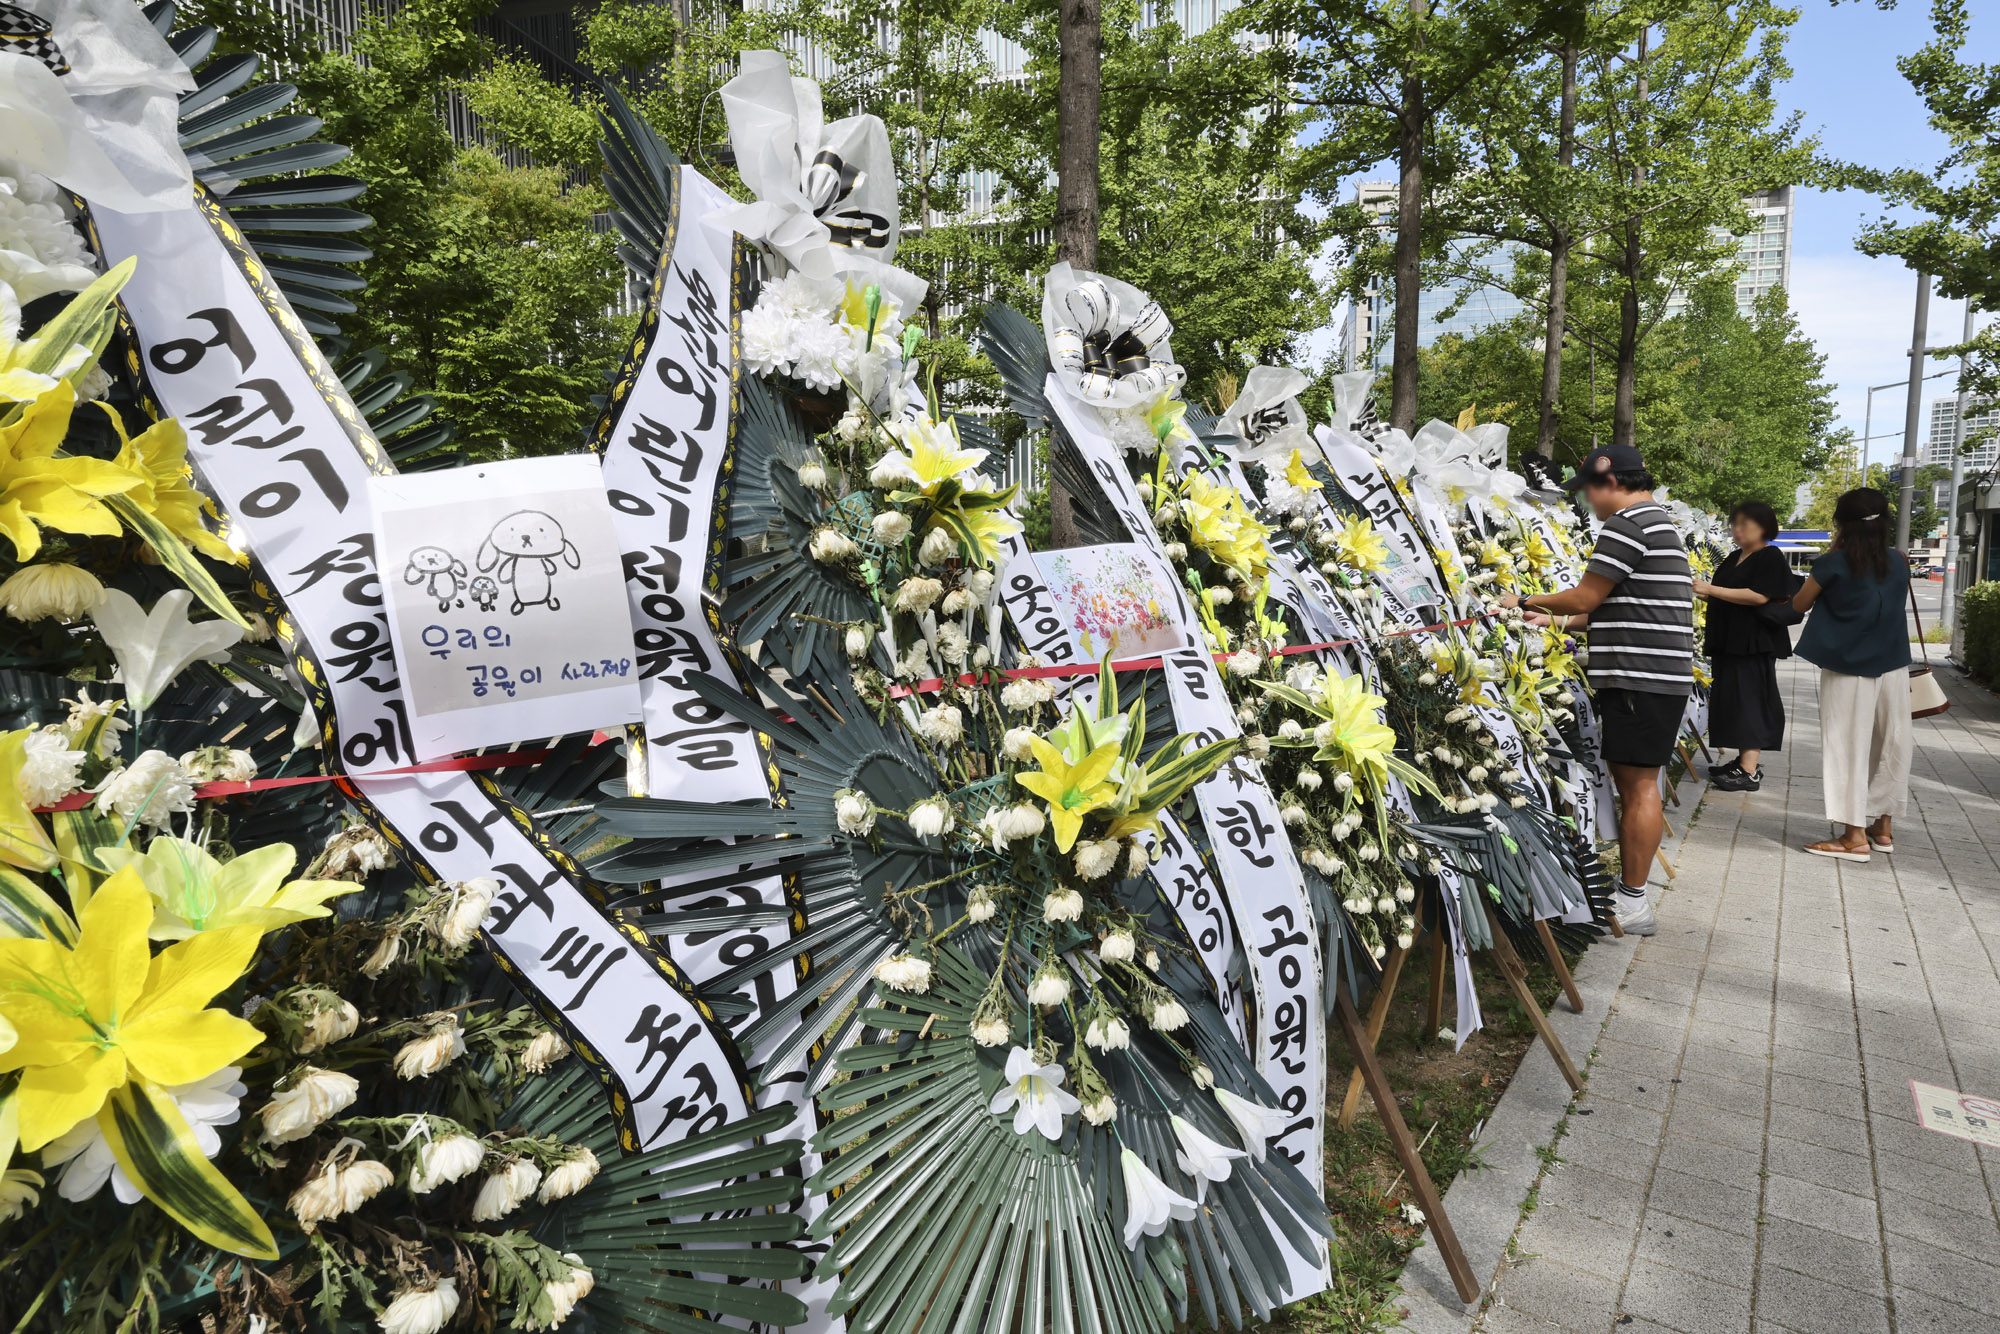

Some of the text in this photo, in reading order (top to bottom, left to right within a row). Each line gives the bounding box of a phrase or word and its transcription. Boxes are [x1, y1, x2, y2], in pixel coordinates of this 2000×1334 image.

[421, 625, 511, 660] 우리의
[466, 665, 542, 697] 공원이
[419, 801, 628, 1011] 아파트
